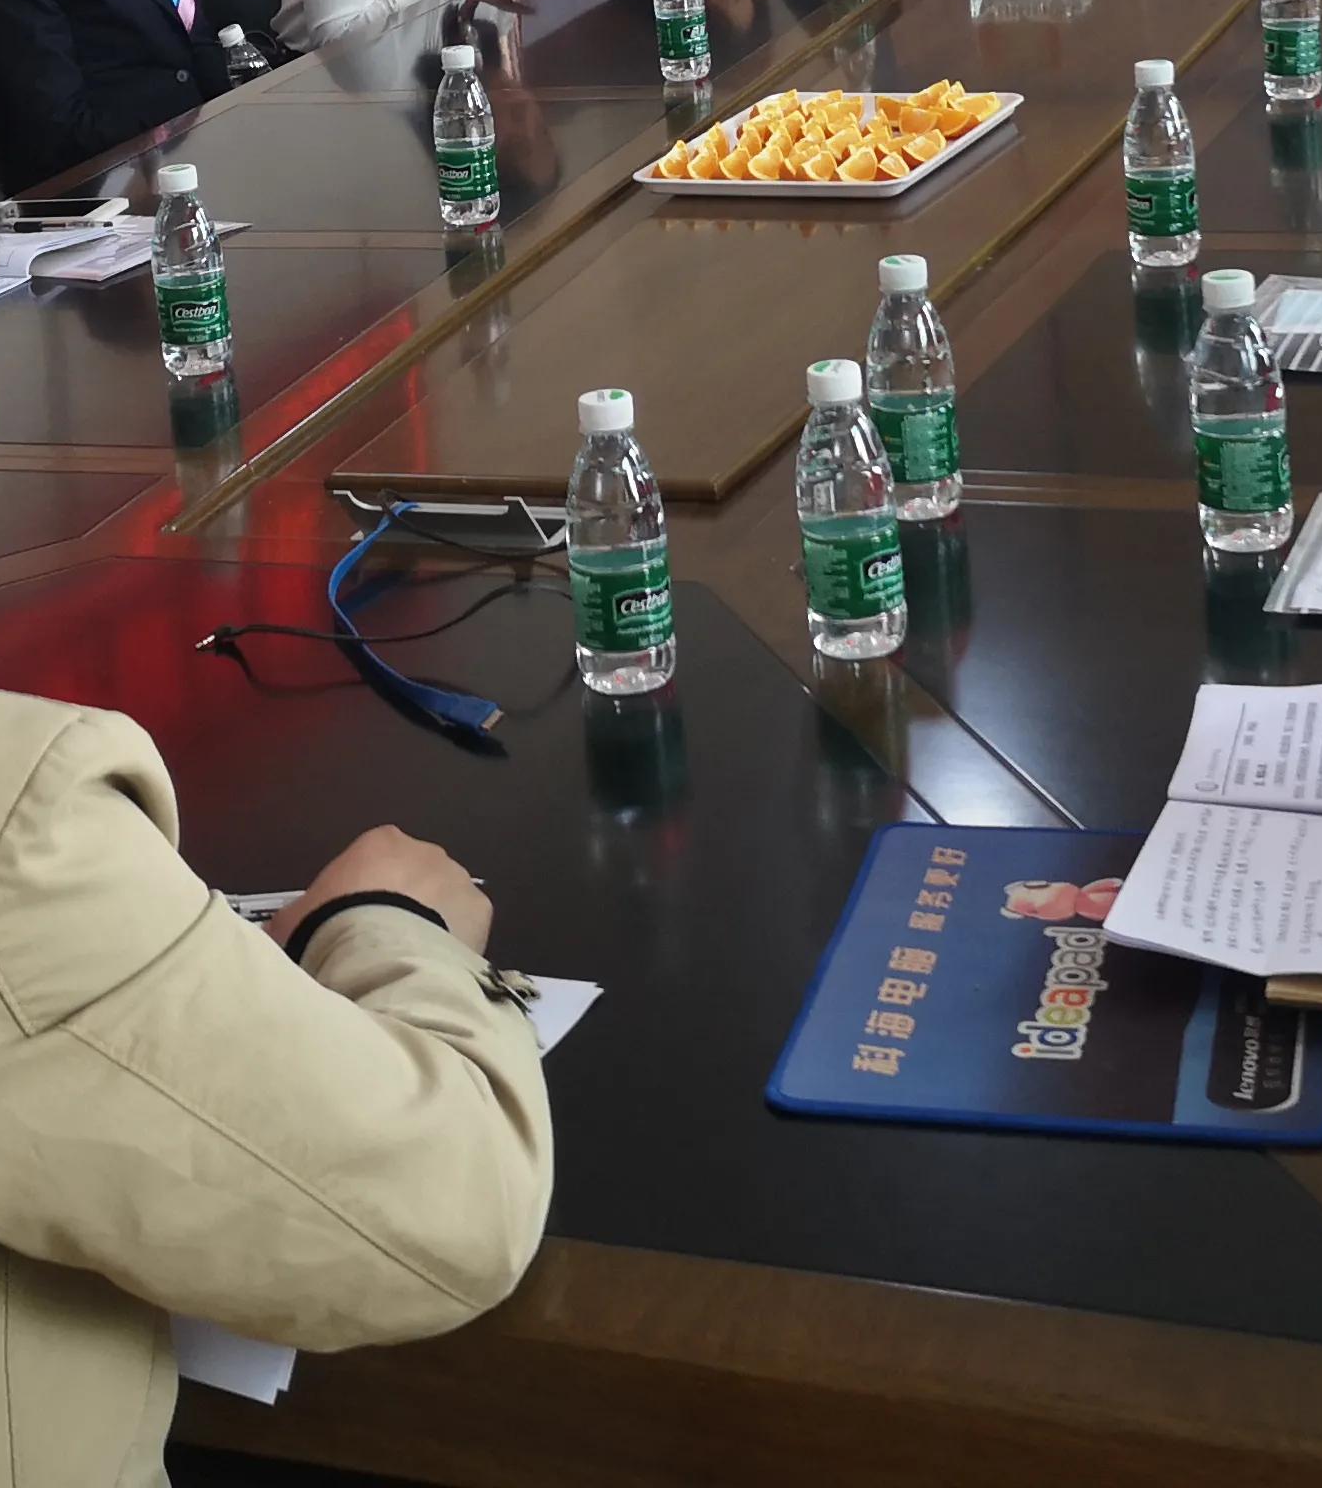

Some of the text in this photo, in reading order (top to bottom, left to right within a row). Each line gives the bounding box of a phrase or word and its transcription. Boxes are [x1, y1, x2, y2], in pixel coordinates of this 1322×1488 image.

[175, 305, 217, 319] Cestbon
[852, 945, 938, 1077] 科海电脑
[1011, 926, 1107, 1060] ideapad
[1232, 1039, 1259, 1100] lenovo
